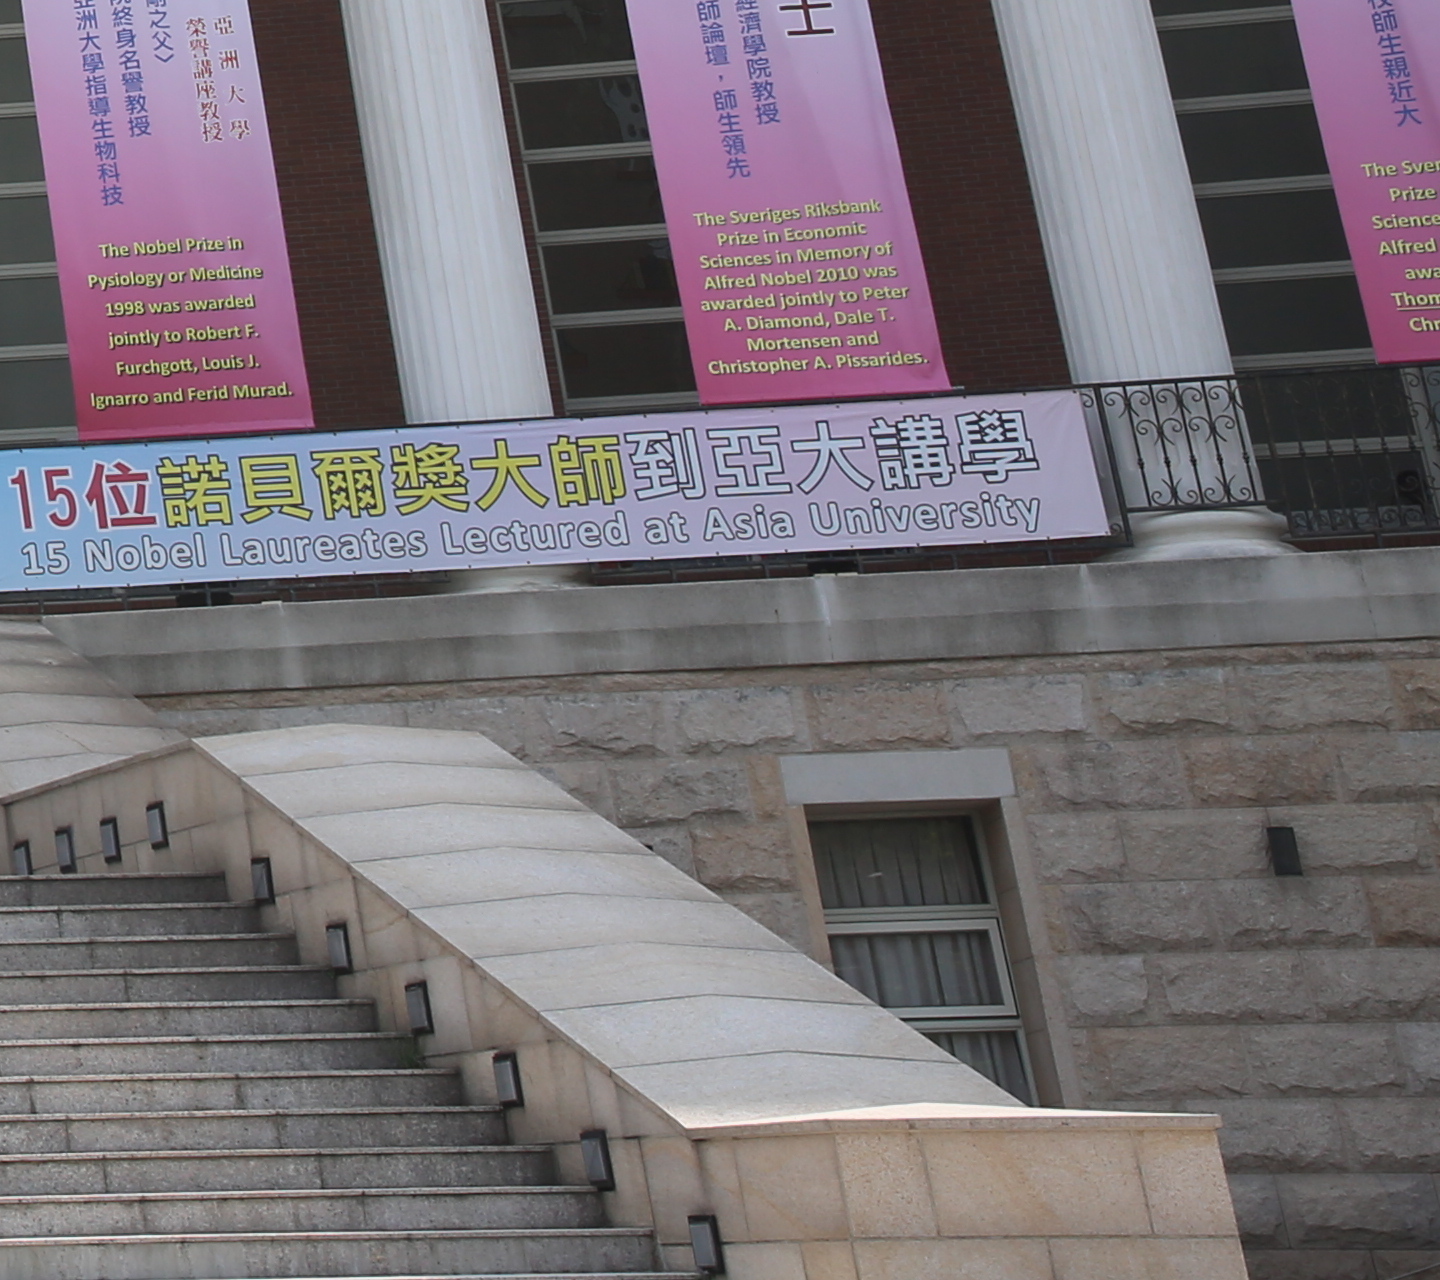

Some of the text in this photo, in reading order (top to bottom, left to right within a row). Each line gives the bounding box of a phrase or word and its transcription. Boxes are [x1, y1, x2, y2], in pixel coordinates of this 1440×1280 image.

[1361, 163, 1397, 178] The
[1390, 187, 1437, 202] Prize
[1379, 238, 1437, 256] Alfred
[169, 270, 185, 283] or
[190, 265, 262, 281] Medicine
[701, 286, 909, 311] awarded jointly to Peter
[724, 309, 895, 332] A. Diamond, Dale T.
[109, 324, 259, 349] jointly to Robert F.
[747, 331, 879, 352] Mortensen and
[116, 354, 260, 376] Furchgott, Louis J.
[708, 351, 929, 375] Christopher A. Pissarides.
[91, 382, 292, 410] Ignarro and Ferid Murad.
[8, 410, 1039, 531] 15位諾貝爾獎大師到亞大講學
[21, 492, 1040, 576] 15 Nobel Laureates Lectured at Asia University
